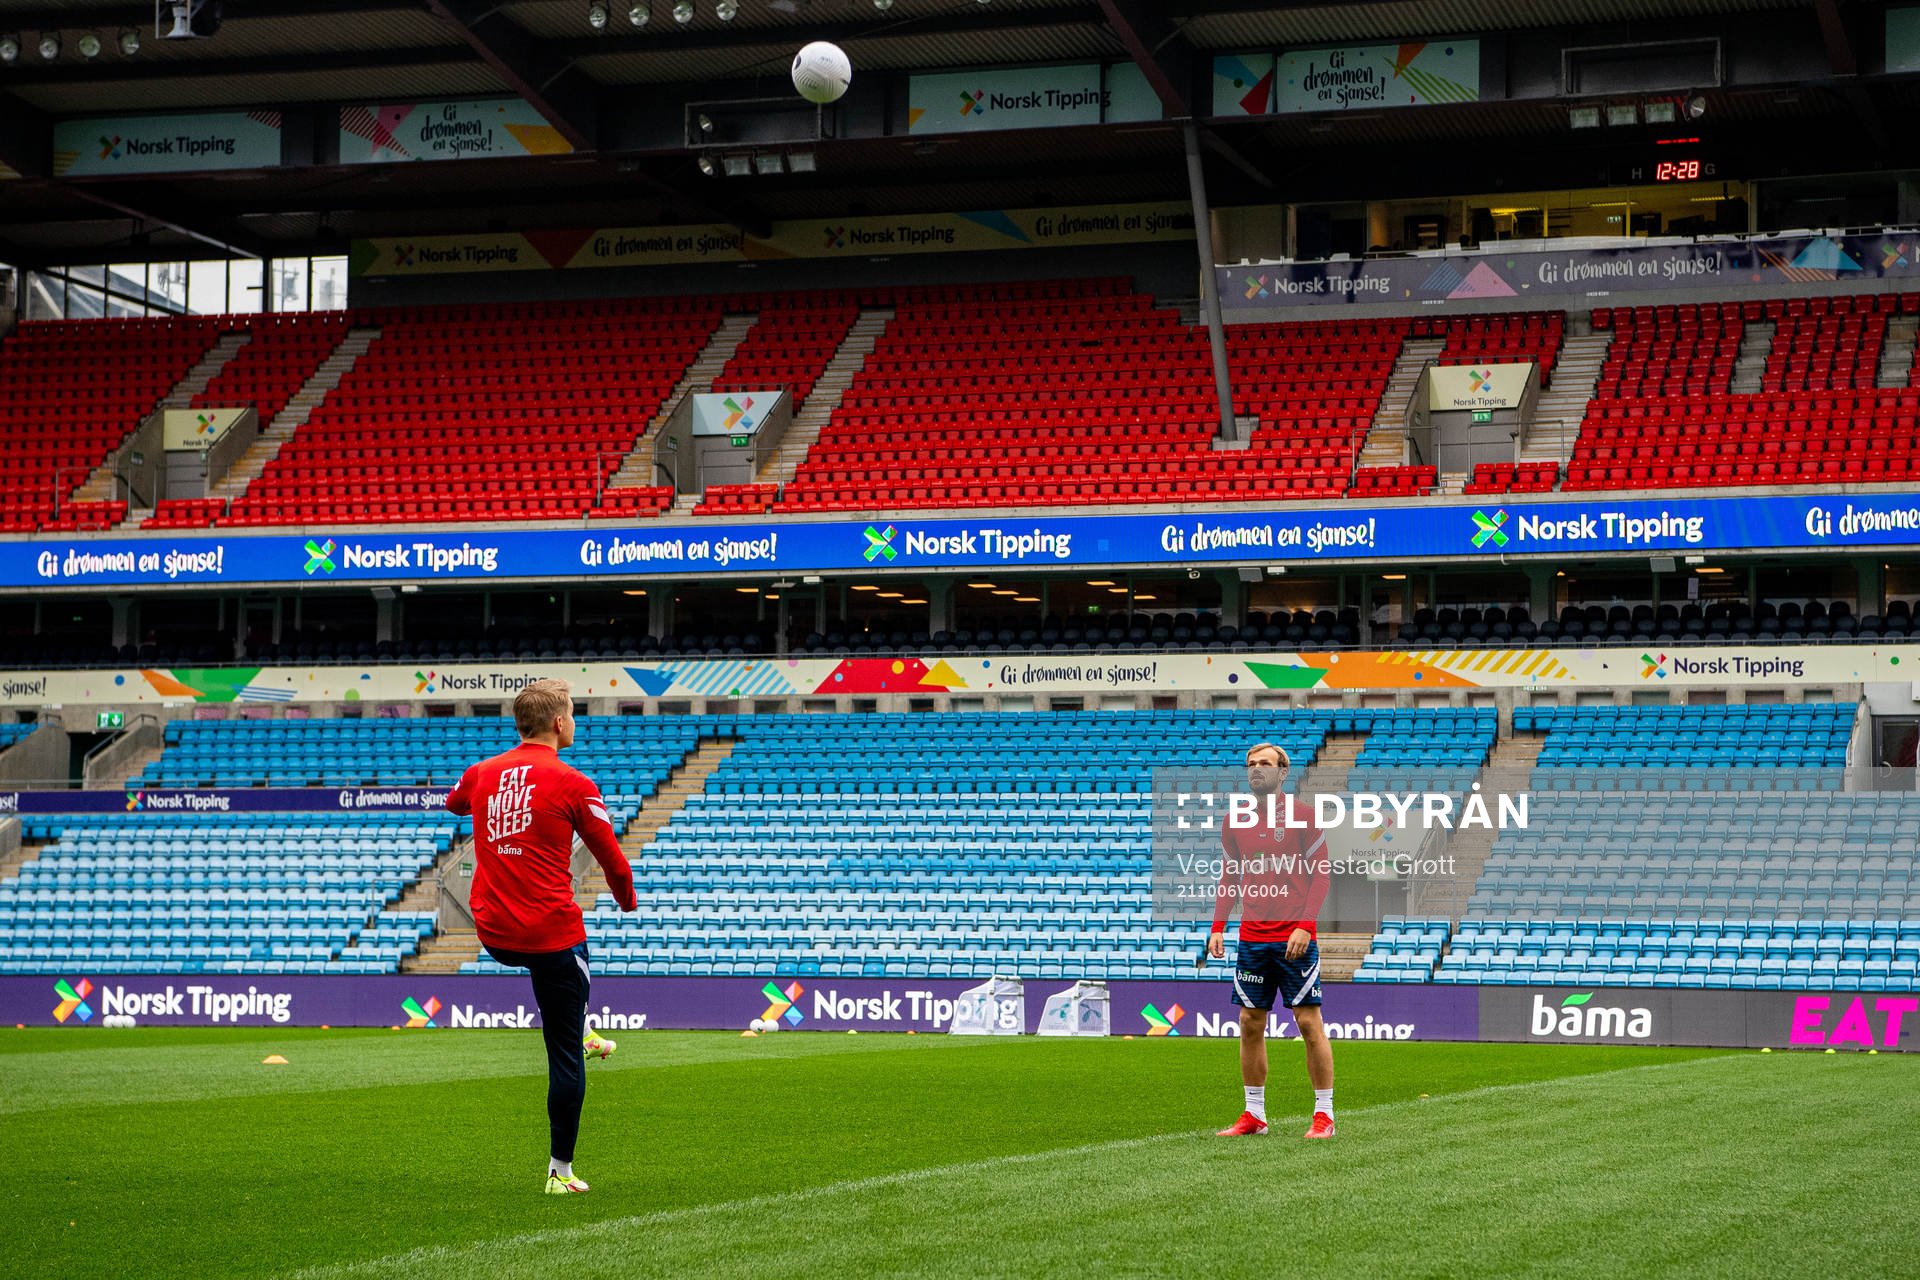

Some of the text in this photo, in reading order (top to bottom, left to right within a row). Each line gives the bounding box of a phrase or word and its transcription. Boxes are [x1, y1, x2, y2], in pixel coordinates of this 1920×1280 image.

[1329, 51, 1344, 68] Gi
[1303, 62, 1373, 91] drømmen
[990, 88, 1111, 110] Norsk Tipping
[1318, 76, 1385, 108] en sjanse!
[443, 104, 456, 121] Gi
[421, 115, 481, 141] drømmen
[127, 135, 235, 156] Norsk Tipping
[433, 130, 492, 154] en sjanse!
[1656, 161, 1700, 180] 12:28
[850, 226, 954, 245] Norsk Tipping
[1036, 216, 1052, 237] Gi
[1058, 214, 1120, 236] drømmen
[1124, 215, 1140, 232] en
[419, 244, 518, 262] Norsk Tipping
[594, 237, 610, 257] Gi
[615, 235, 672, 256] drømmen
[677, 237, 693, 251] en
[1538, 251, 1721, 284] Gi drømmen en sjanse!
[1274, 274, 1390, 296] Norsk Tipping
[1453, 396, 1507, 407] Norsk Tipping
[1518, 511, 1704, 543] Norsk Tipping
[1805, 504, 1920, 538] Gi drømme
[905, 528, 1072, 559] Norsk Tipping
[1161, 517, 1376, 554] Gi drømmen en sjanse!
[343, 542, 498, 572] Norsk Tipping
[580, 532, 777, 567] Gi drømmen en sjanse!
[37, 545, 224, 579] Gi drømmen en sjanse!
[1000, 661, 1157, 687] Gi drømmen en sjanse!
[1673, 656, 1804, 678] Norsk Tipping
[2, 676, 47, 700] sjanse!
[441, 673, 548, 692] Norsk Tippin
[498, 764, 533, 793] EAT
[147, 793, 230, 811] Norsk Tipping
[339, 790, 353, 809] Gi
[404, 791, 418, 805] en
[420, 790, 448, 810] sjans
[487, 784, 536, 820] MOVE
[487, 812, 532, 843] SLEEP
[1351, 847, 1377, 857] Norsk
[102, 985, 292, 1022] Norsk Tipping
[814, 989, 902, 1020] Norsk
[450, 1004, 535, 1028] Norsk
[1788, 995, 1920, 1047] EAT
